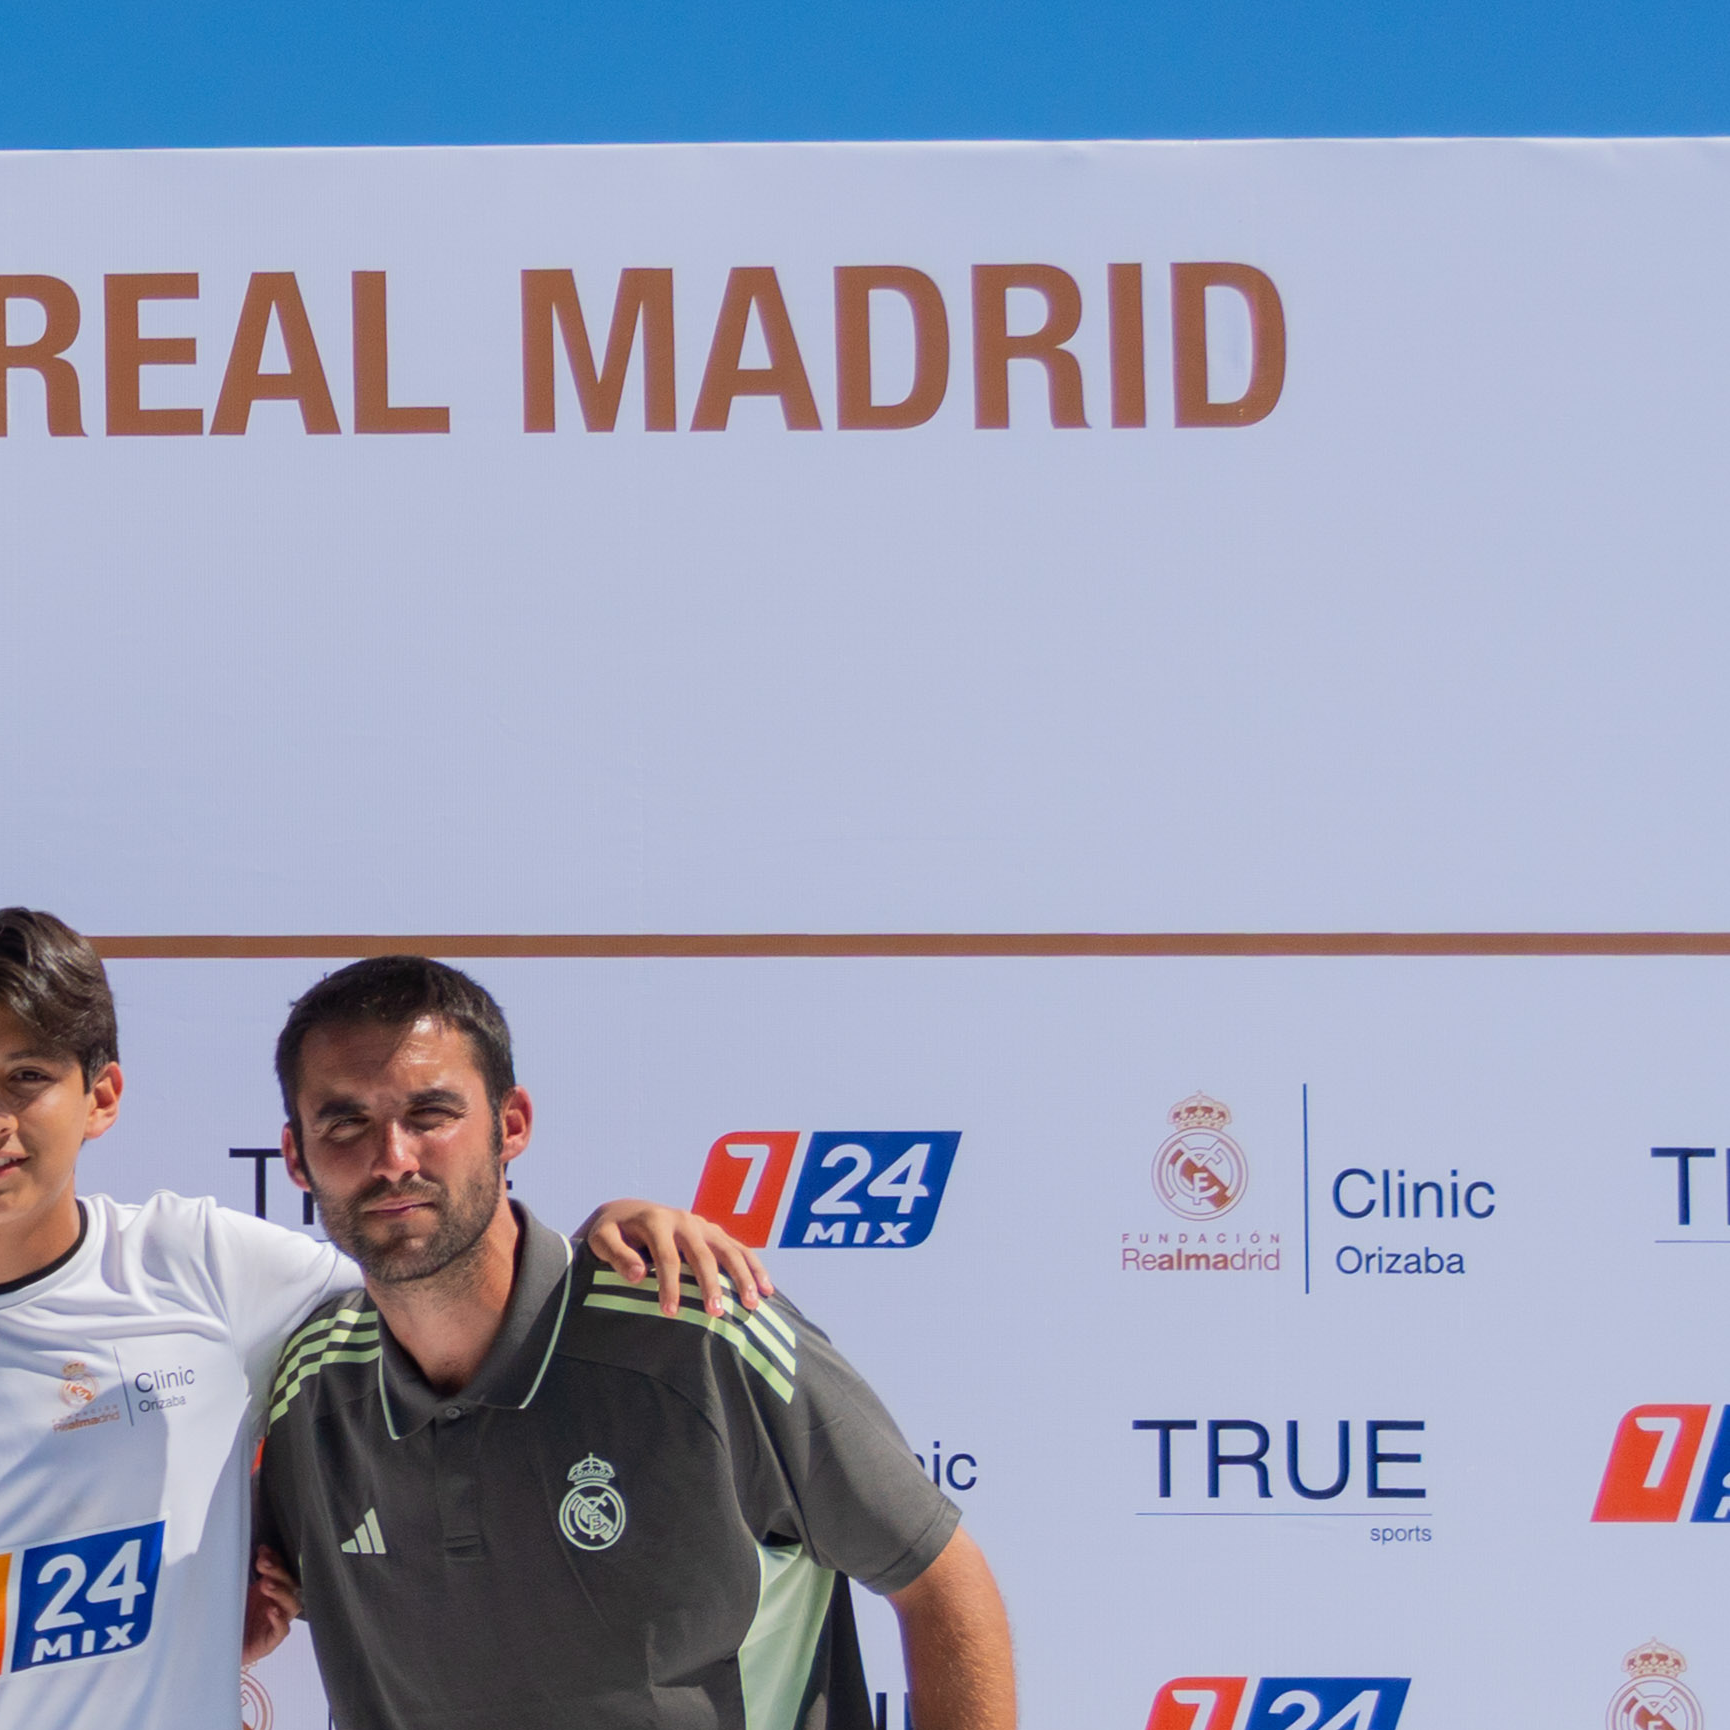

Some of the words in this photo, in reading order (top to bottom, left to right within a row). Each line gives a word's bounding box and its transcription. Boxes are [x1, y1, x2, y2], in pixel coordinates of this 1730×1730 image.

[520, 261, 1287, 433] MADRID
[811, 1143, 931, 1218] 24
[1331, 1167, 1496, 1220] Clinic
[802, 1222, 911, 1245] MIX
[1122, 1230, 1281, 1244] FUNDACIÓN
[1122, 1246, 1281, 1272] Realmadrid
[1335, 1245, 1466, 1275] Orizaba
[134, 1366, 196, 1393] Clinic
[138, 1395, 187, 1413] Orizaba
[1132, 1419, 1427, 1500] TRUE
[1369, 1524, 1432, 1545] sports
[33, 1539, 147, 1627] 24
[30, 1624, 136, 1663] MIX
